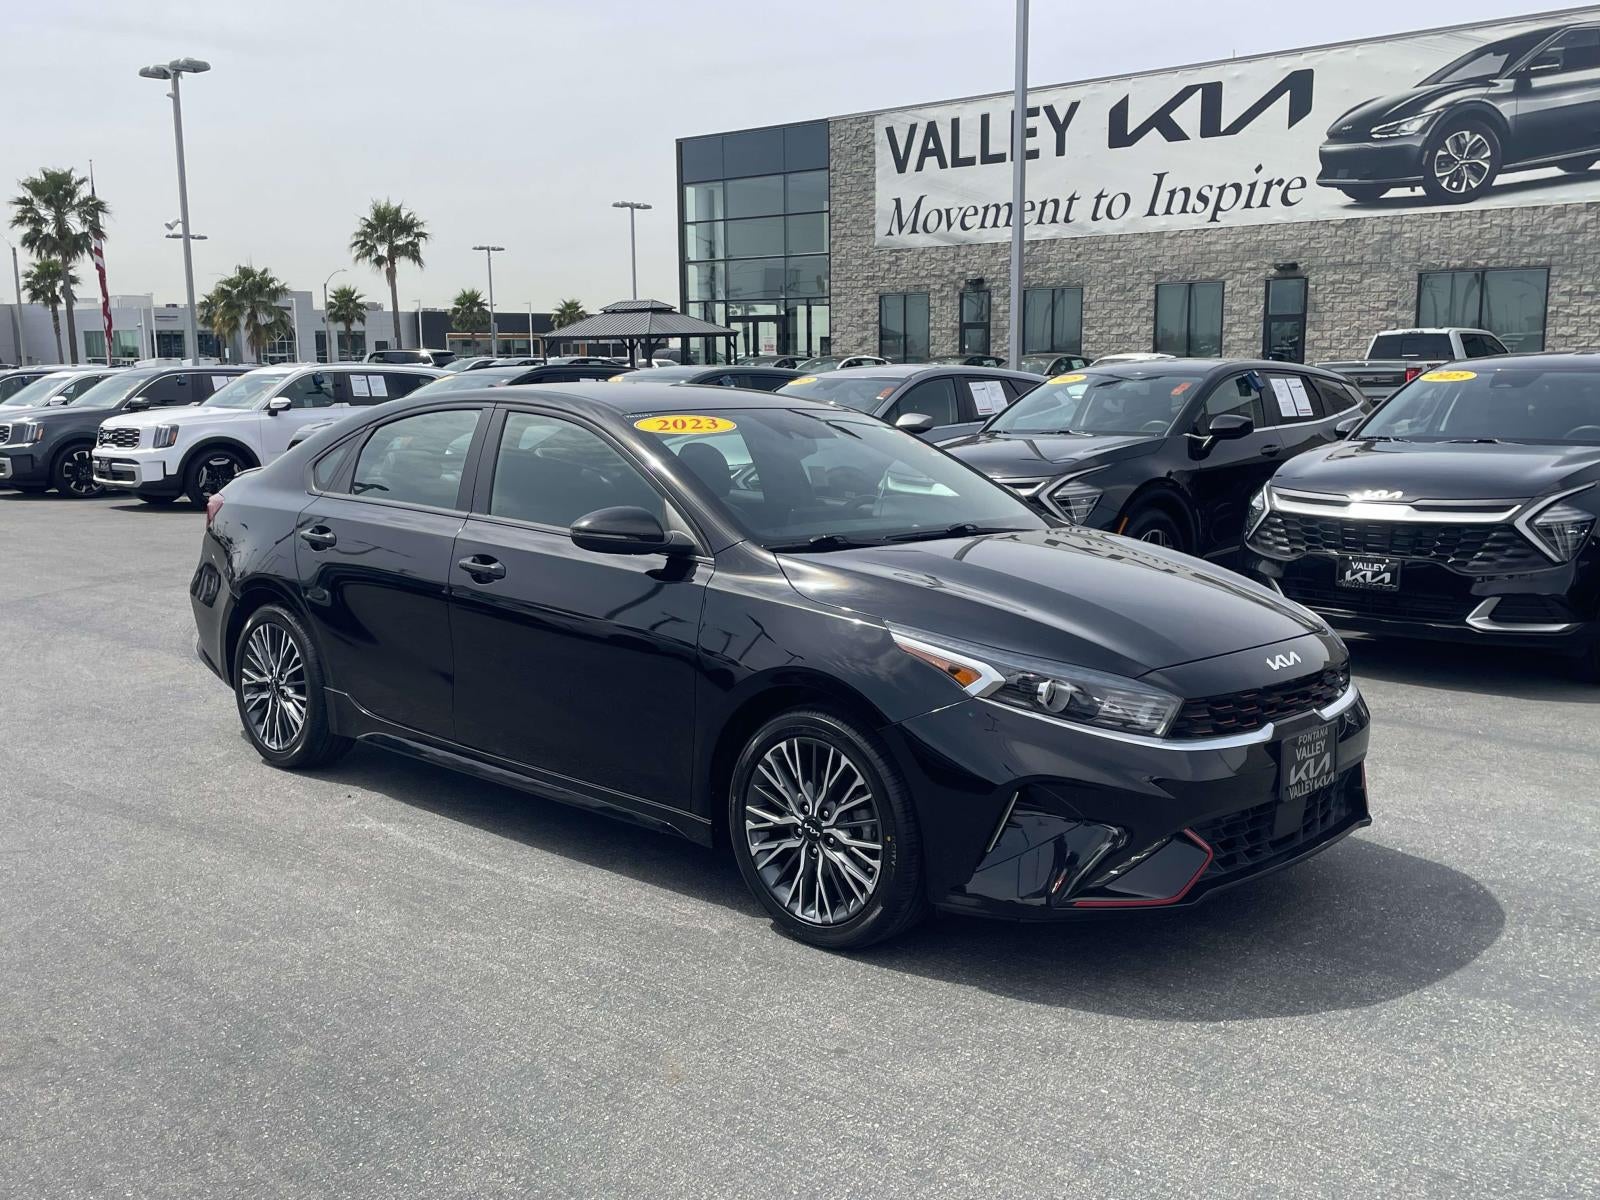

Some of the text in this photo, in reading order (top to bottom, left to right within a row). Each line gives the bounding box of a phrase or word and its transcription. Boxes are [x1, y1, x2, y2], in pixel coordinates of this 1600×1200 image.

[885, 68, 1314, 175] VALLEY KIA
[885, 163, 1308, 236] Movement to Inspire
[656, 418, 719, 431] 2023
[1351, 561, 1386, 571] VALLEY
[1345, 570, 1391, 584] KIA
[1266, 651, 1302, 671] KIA
[1298, 727, 1329, 746] FONTANA
[1295, 739, 1326, 761] VALLEY
[1289, 752, 1331, 785] KIA
[1288, 771, 1335, 800] VALLEY KIA
